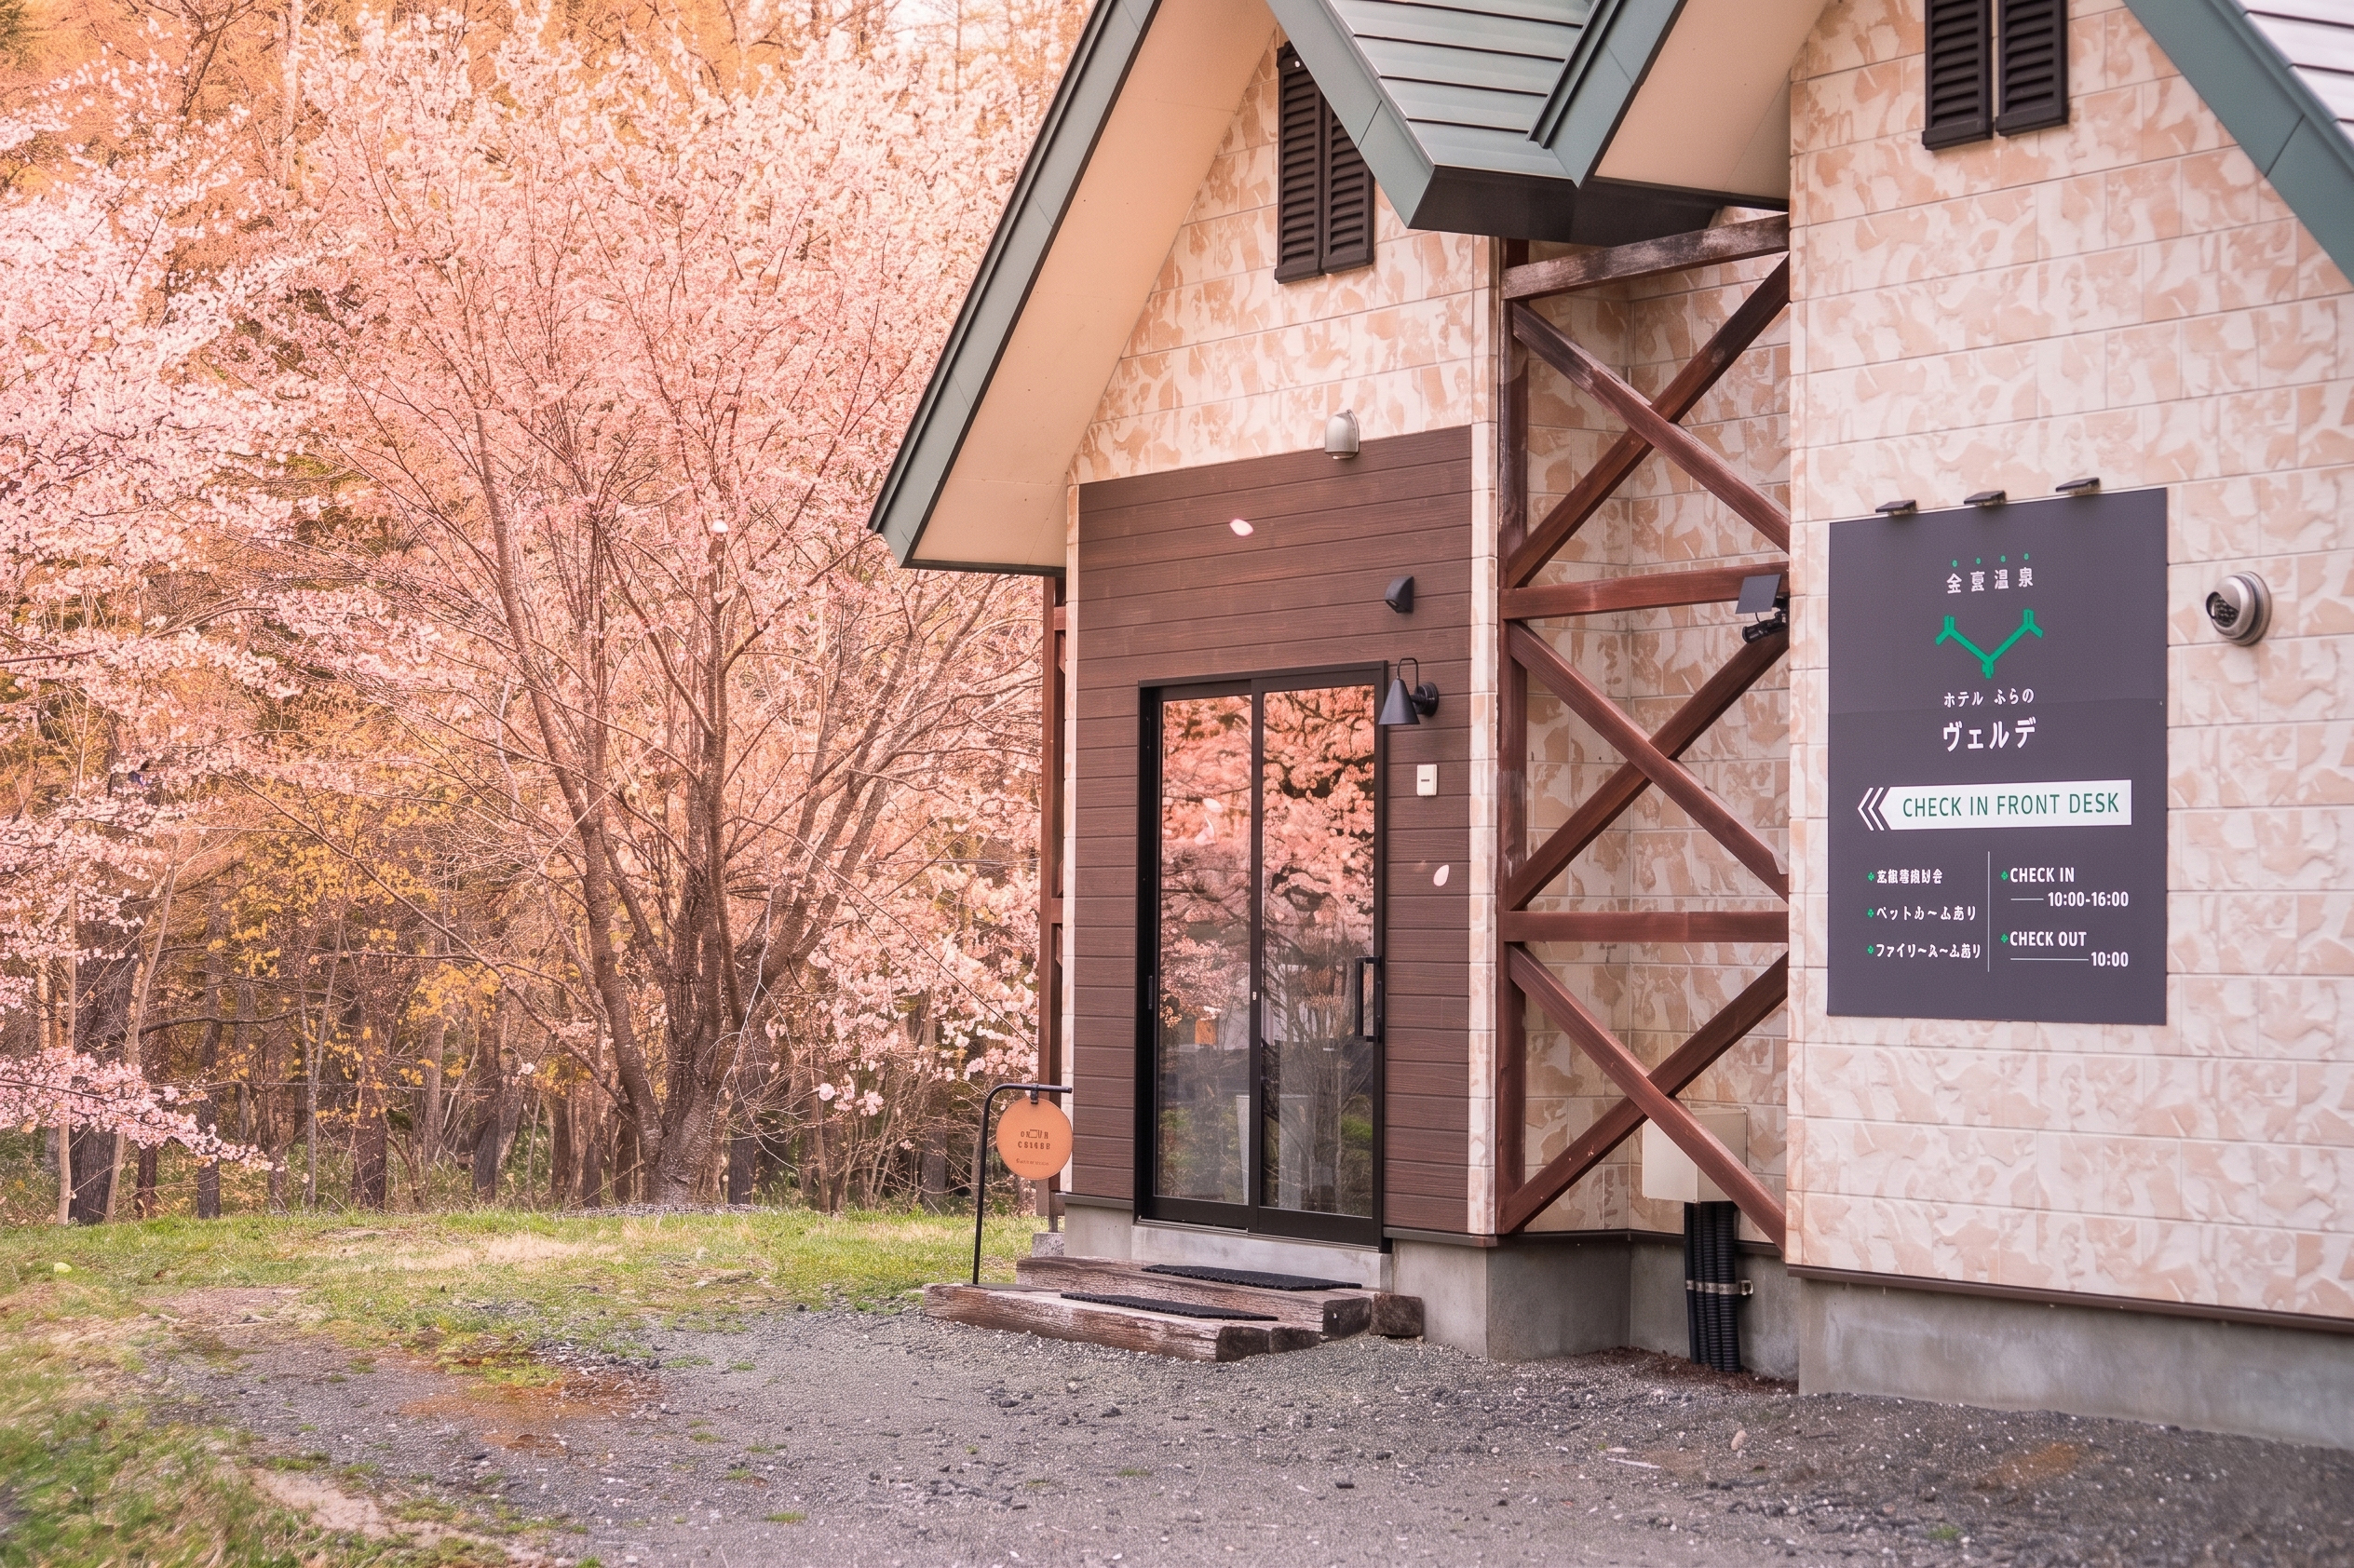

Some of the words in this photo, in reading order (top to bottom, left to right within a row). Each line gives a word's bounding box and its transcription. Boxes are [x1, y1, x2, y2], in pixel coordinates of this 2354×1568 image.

[1943, 690, 1984, 709] ホテル
[1994, 687, 2035, 705] ふらの
[1942, 716, 2036, 752] ヴェルデ
[1902, 796, 1962, 818] CHECK
[1969, 796, 1988, 816] IN
[1996, 794, 2061, 816] FRONT
[2069, 792, 2119, 814] DESK
[2009, 867, 2055, 883] CHECK
[2060, 867, 2075, 883] IN
[2048, 891, 2130, 908] 10:00-16:00
[2009, 930, 2054, 947] CHECK
[2058, 931, 2088, 947] OUT
[2090, 951, 2129, 967] 10:00
